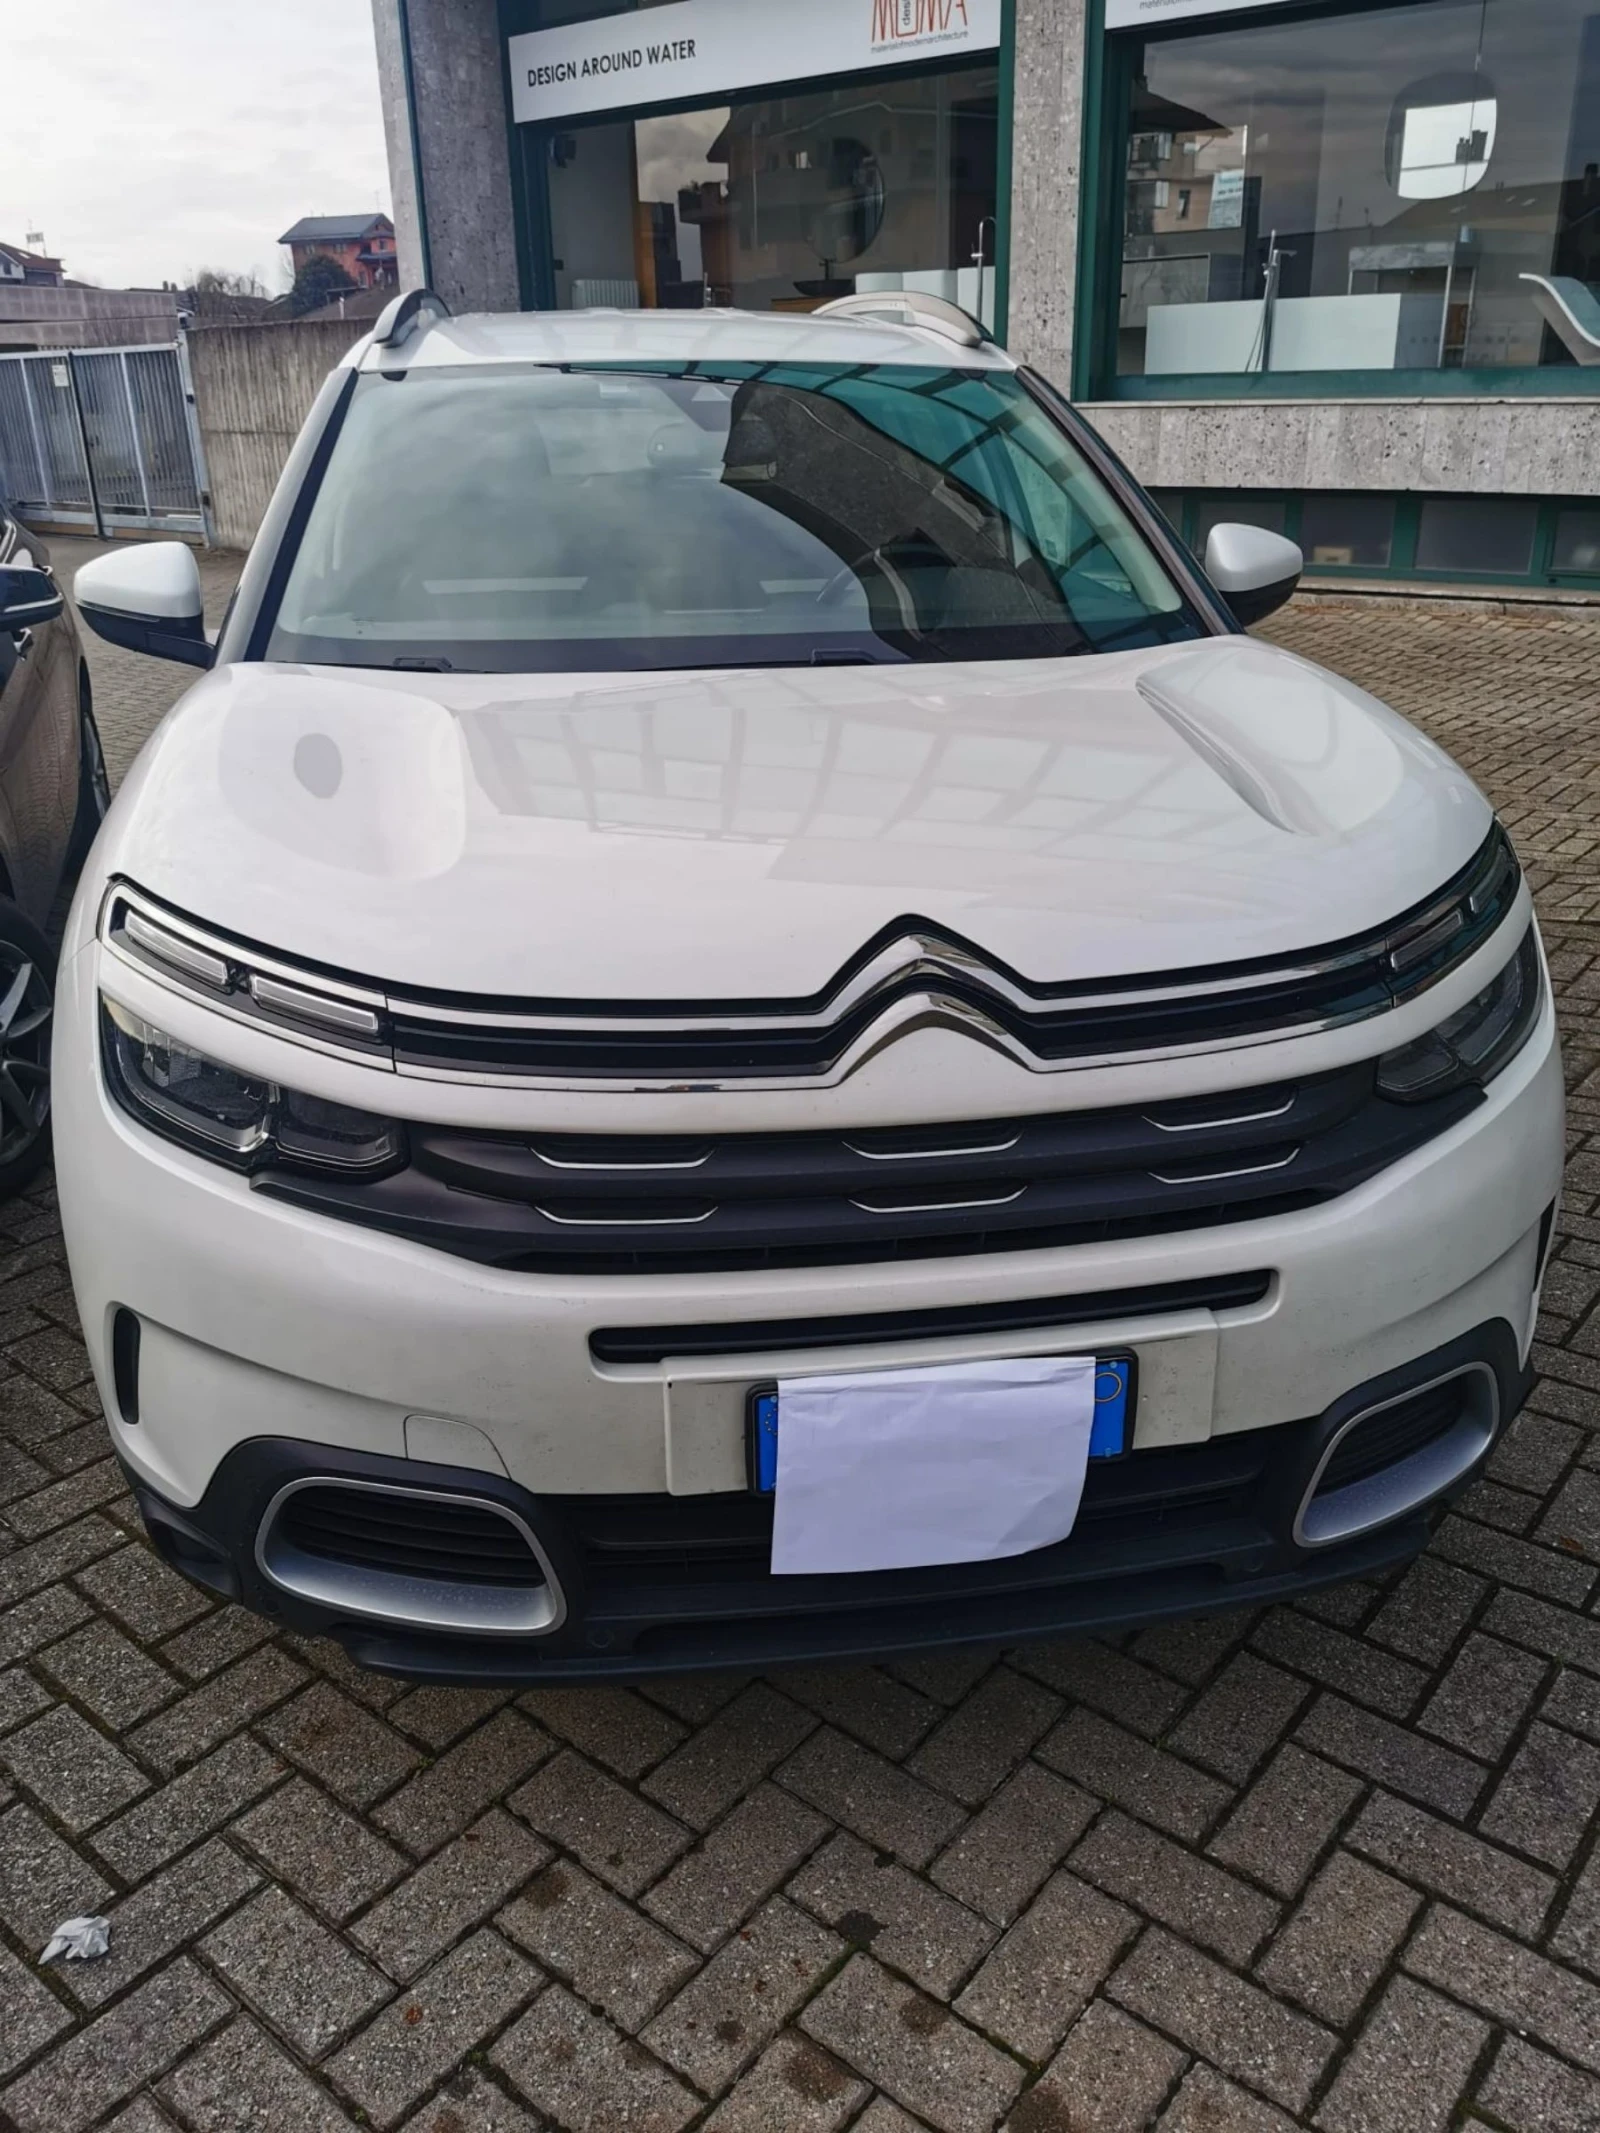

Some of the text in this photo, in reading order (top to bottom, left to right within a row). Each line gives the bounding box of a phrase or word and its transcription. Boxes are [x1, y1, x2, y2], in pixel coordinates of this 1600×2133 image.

[528, 39, 696, 87] DESIGN AROUND WATER
